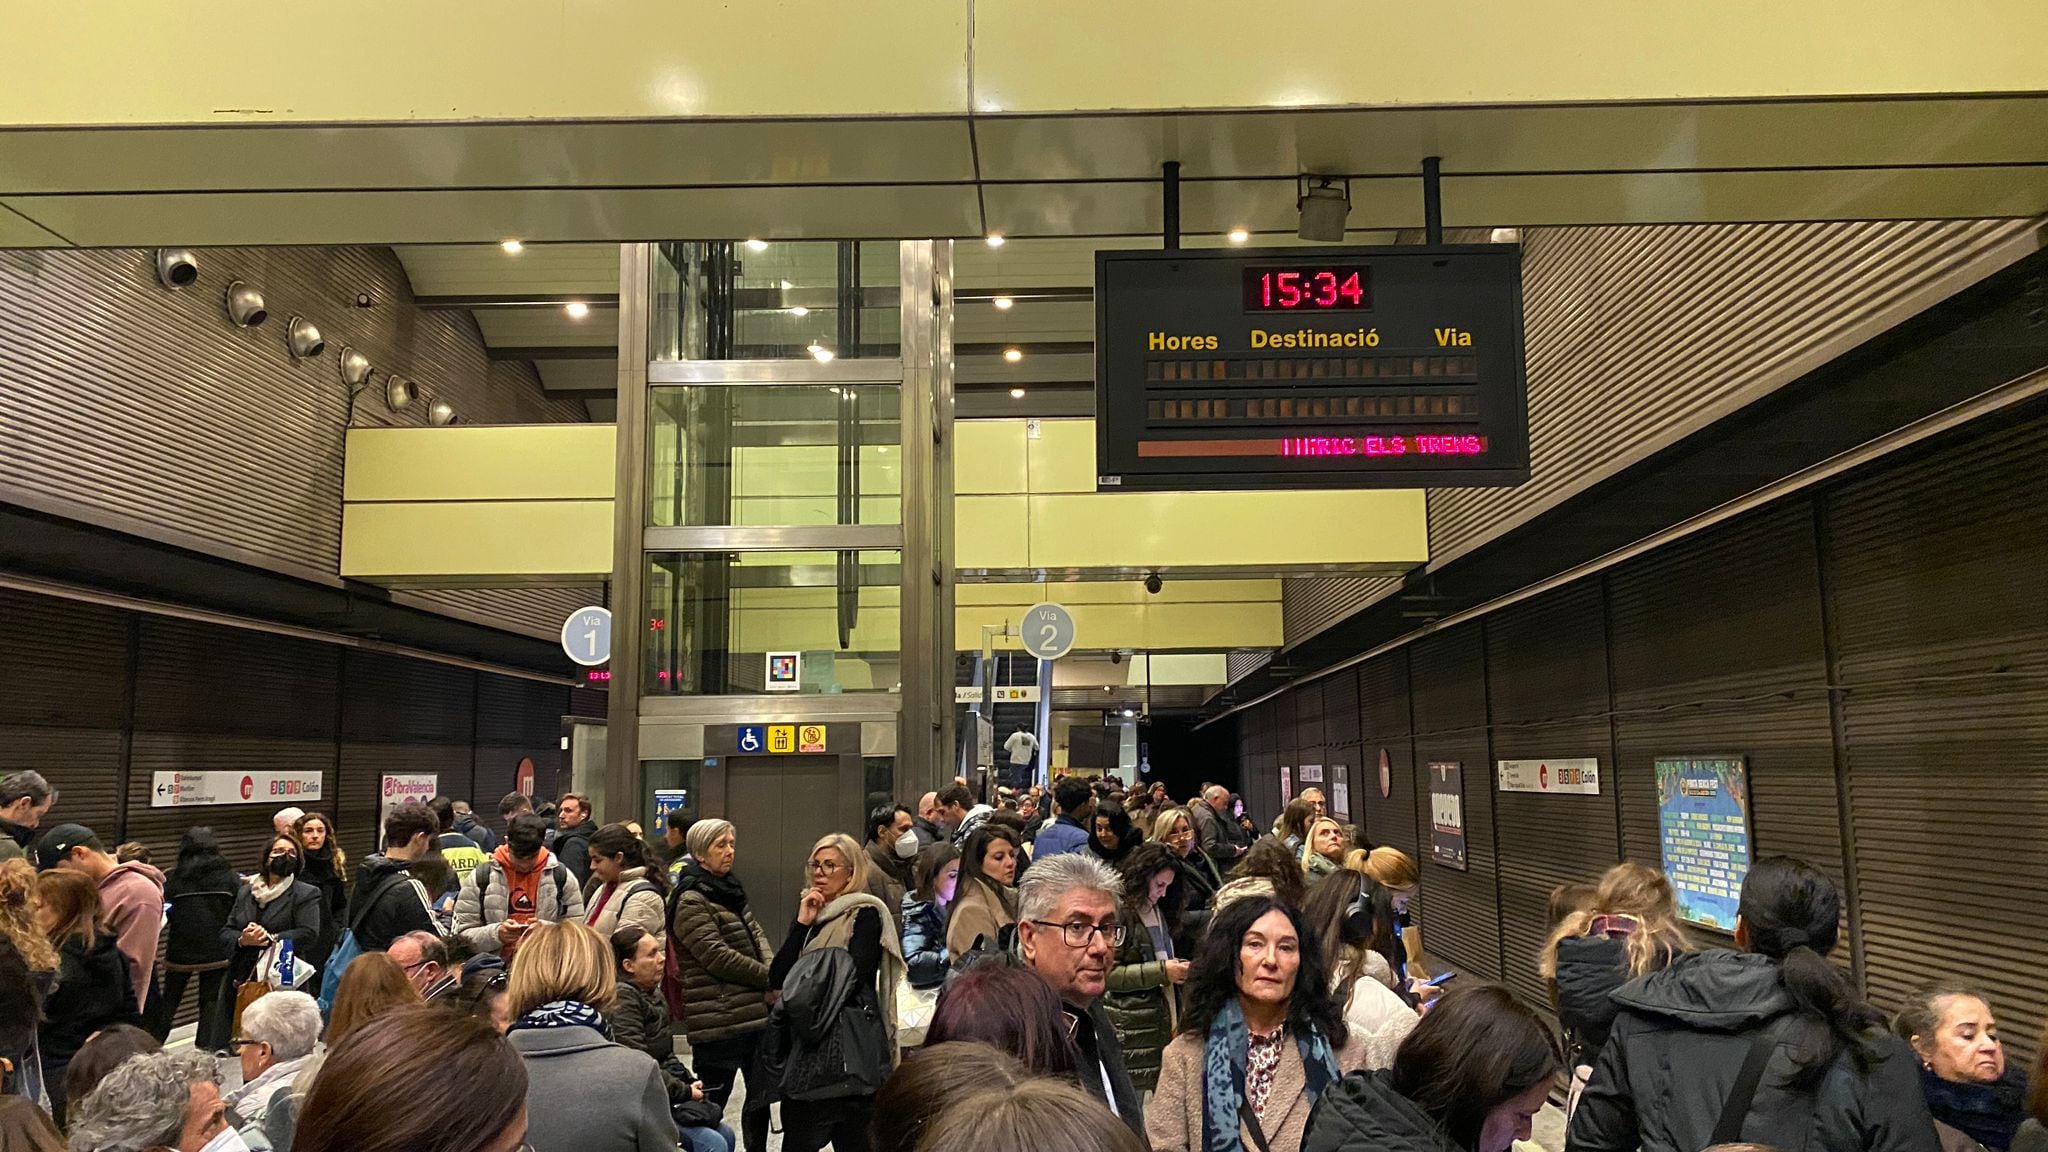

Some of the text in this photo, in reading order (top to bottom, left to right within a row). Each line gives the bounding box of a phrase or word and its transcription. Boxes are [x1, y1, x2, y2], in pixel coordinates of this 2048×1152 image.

[1261, 271, 1363, 307] 15:34
[1148, 327, 1472, 351] Hores Destinació Via
[1366, 436, 1406, 455] ELS
[1415, 436, 1481, 454] TRENS
[583, 615, 601, 626] Via
[1039, 610, 1057, 621] Via
[583, 629, 596, 656] 1
[1040, 624, 1059, 651] 2
[1581, 770, 1596, 784] Colón
[302, 781, 319, 793] Colón
